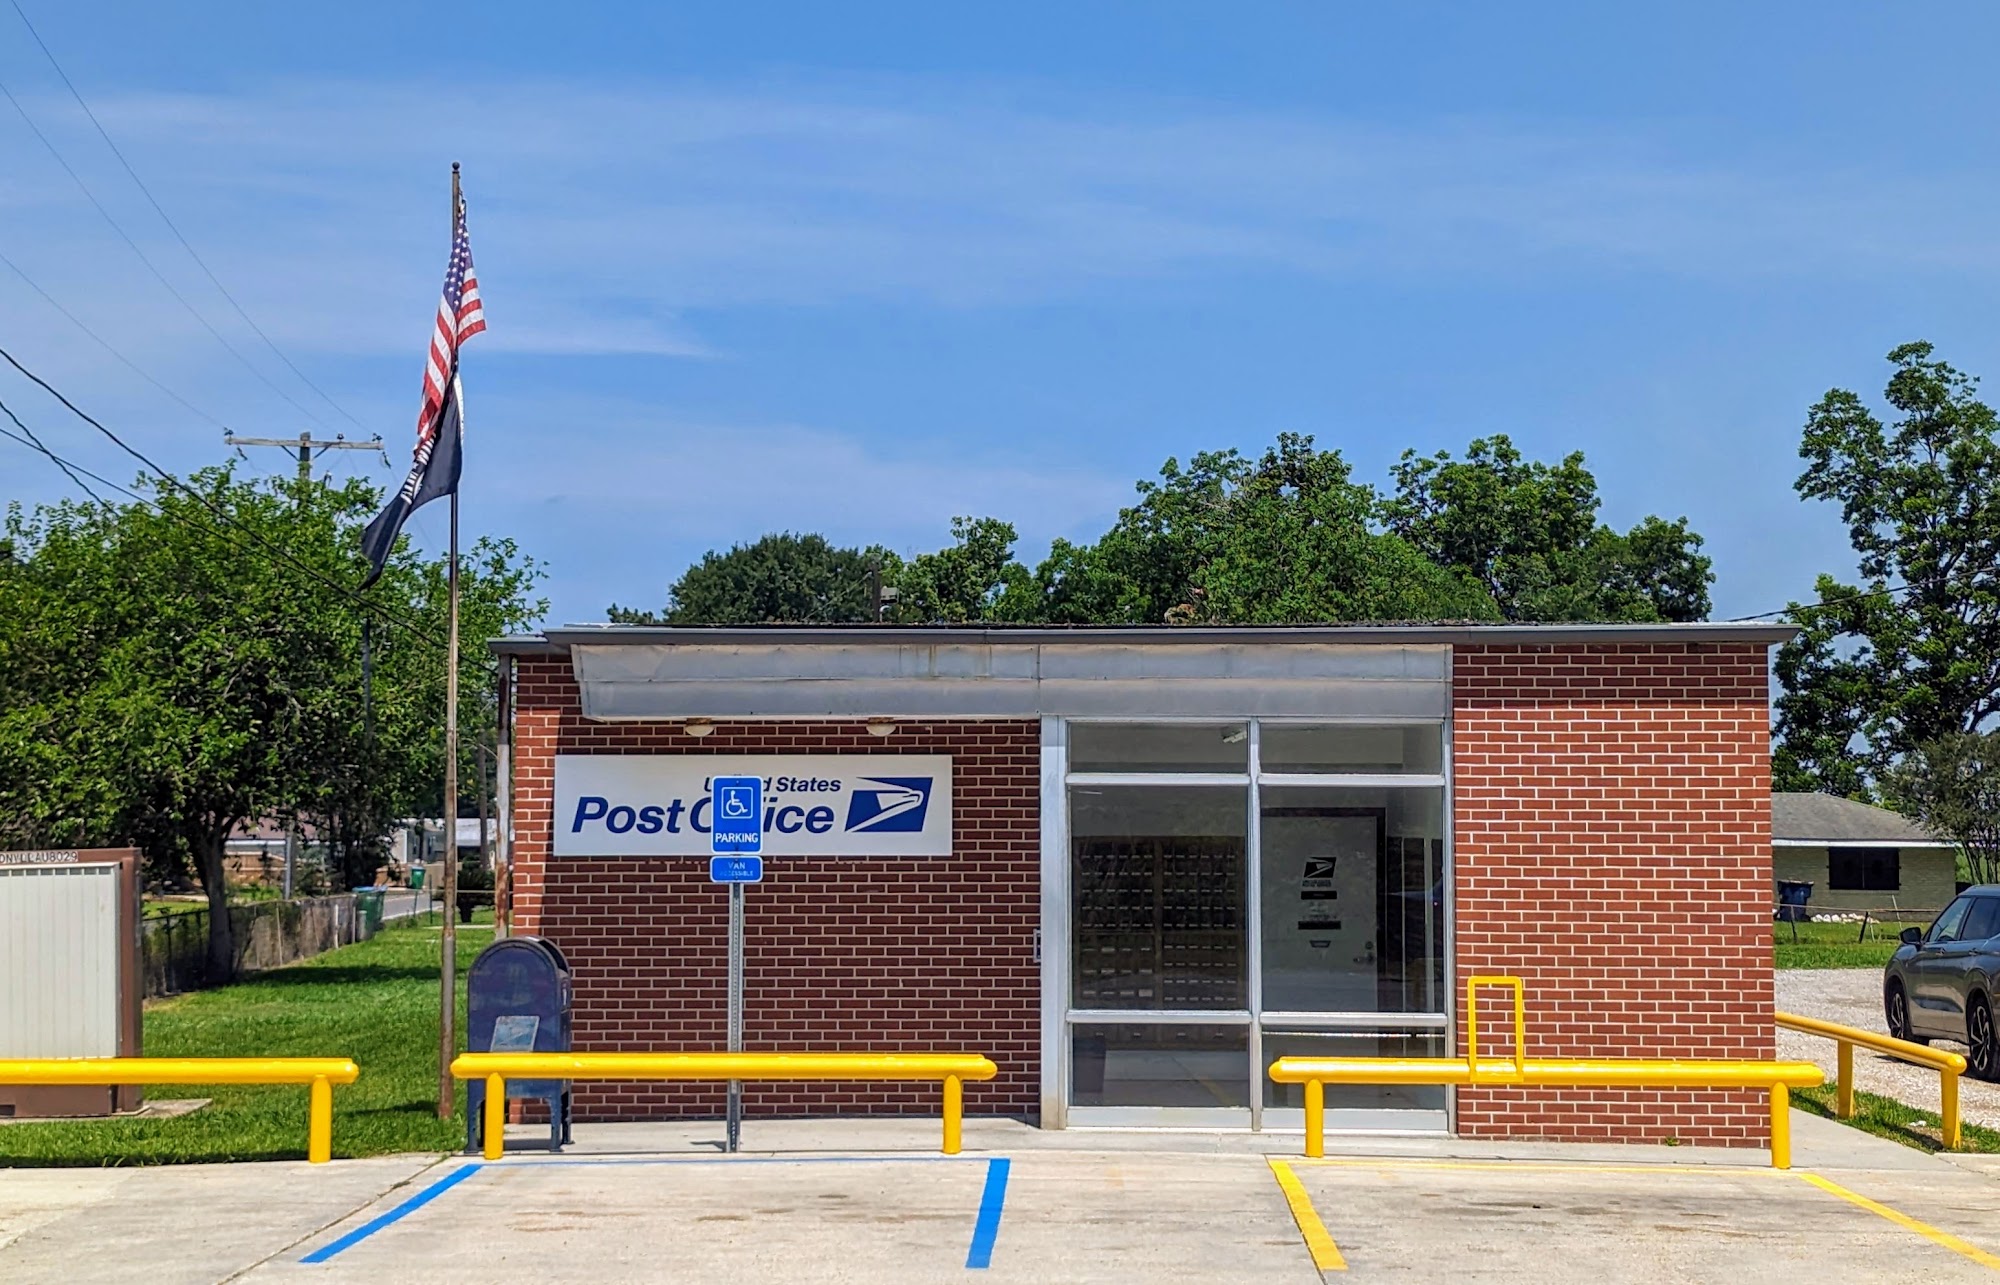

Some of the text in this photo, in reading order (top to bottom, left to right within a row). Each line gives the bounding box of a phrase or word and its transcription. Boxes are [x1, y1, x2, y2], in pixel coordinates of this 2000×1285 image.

[776, 776, 842, 793] States
[571, 796, 835, 834] Post Oice
[714, 832, 759, 843] PARKING
[727, 861, 746, 870] VAN
